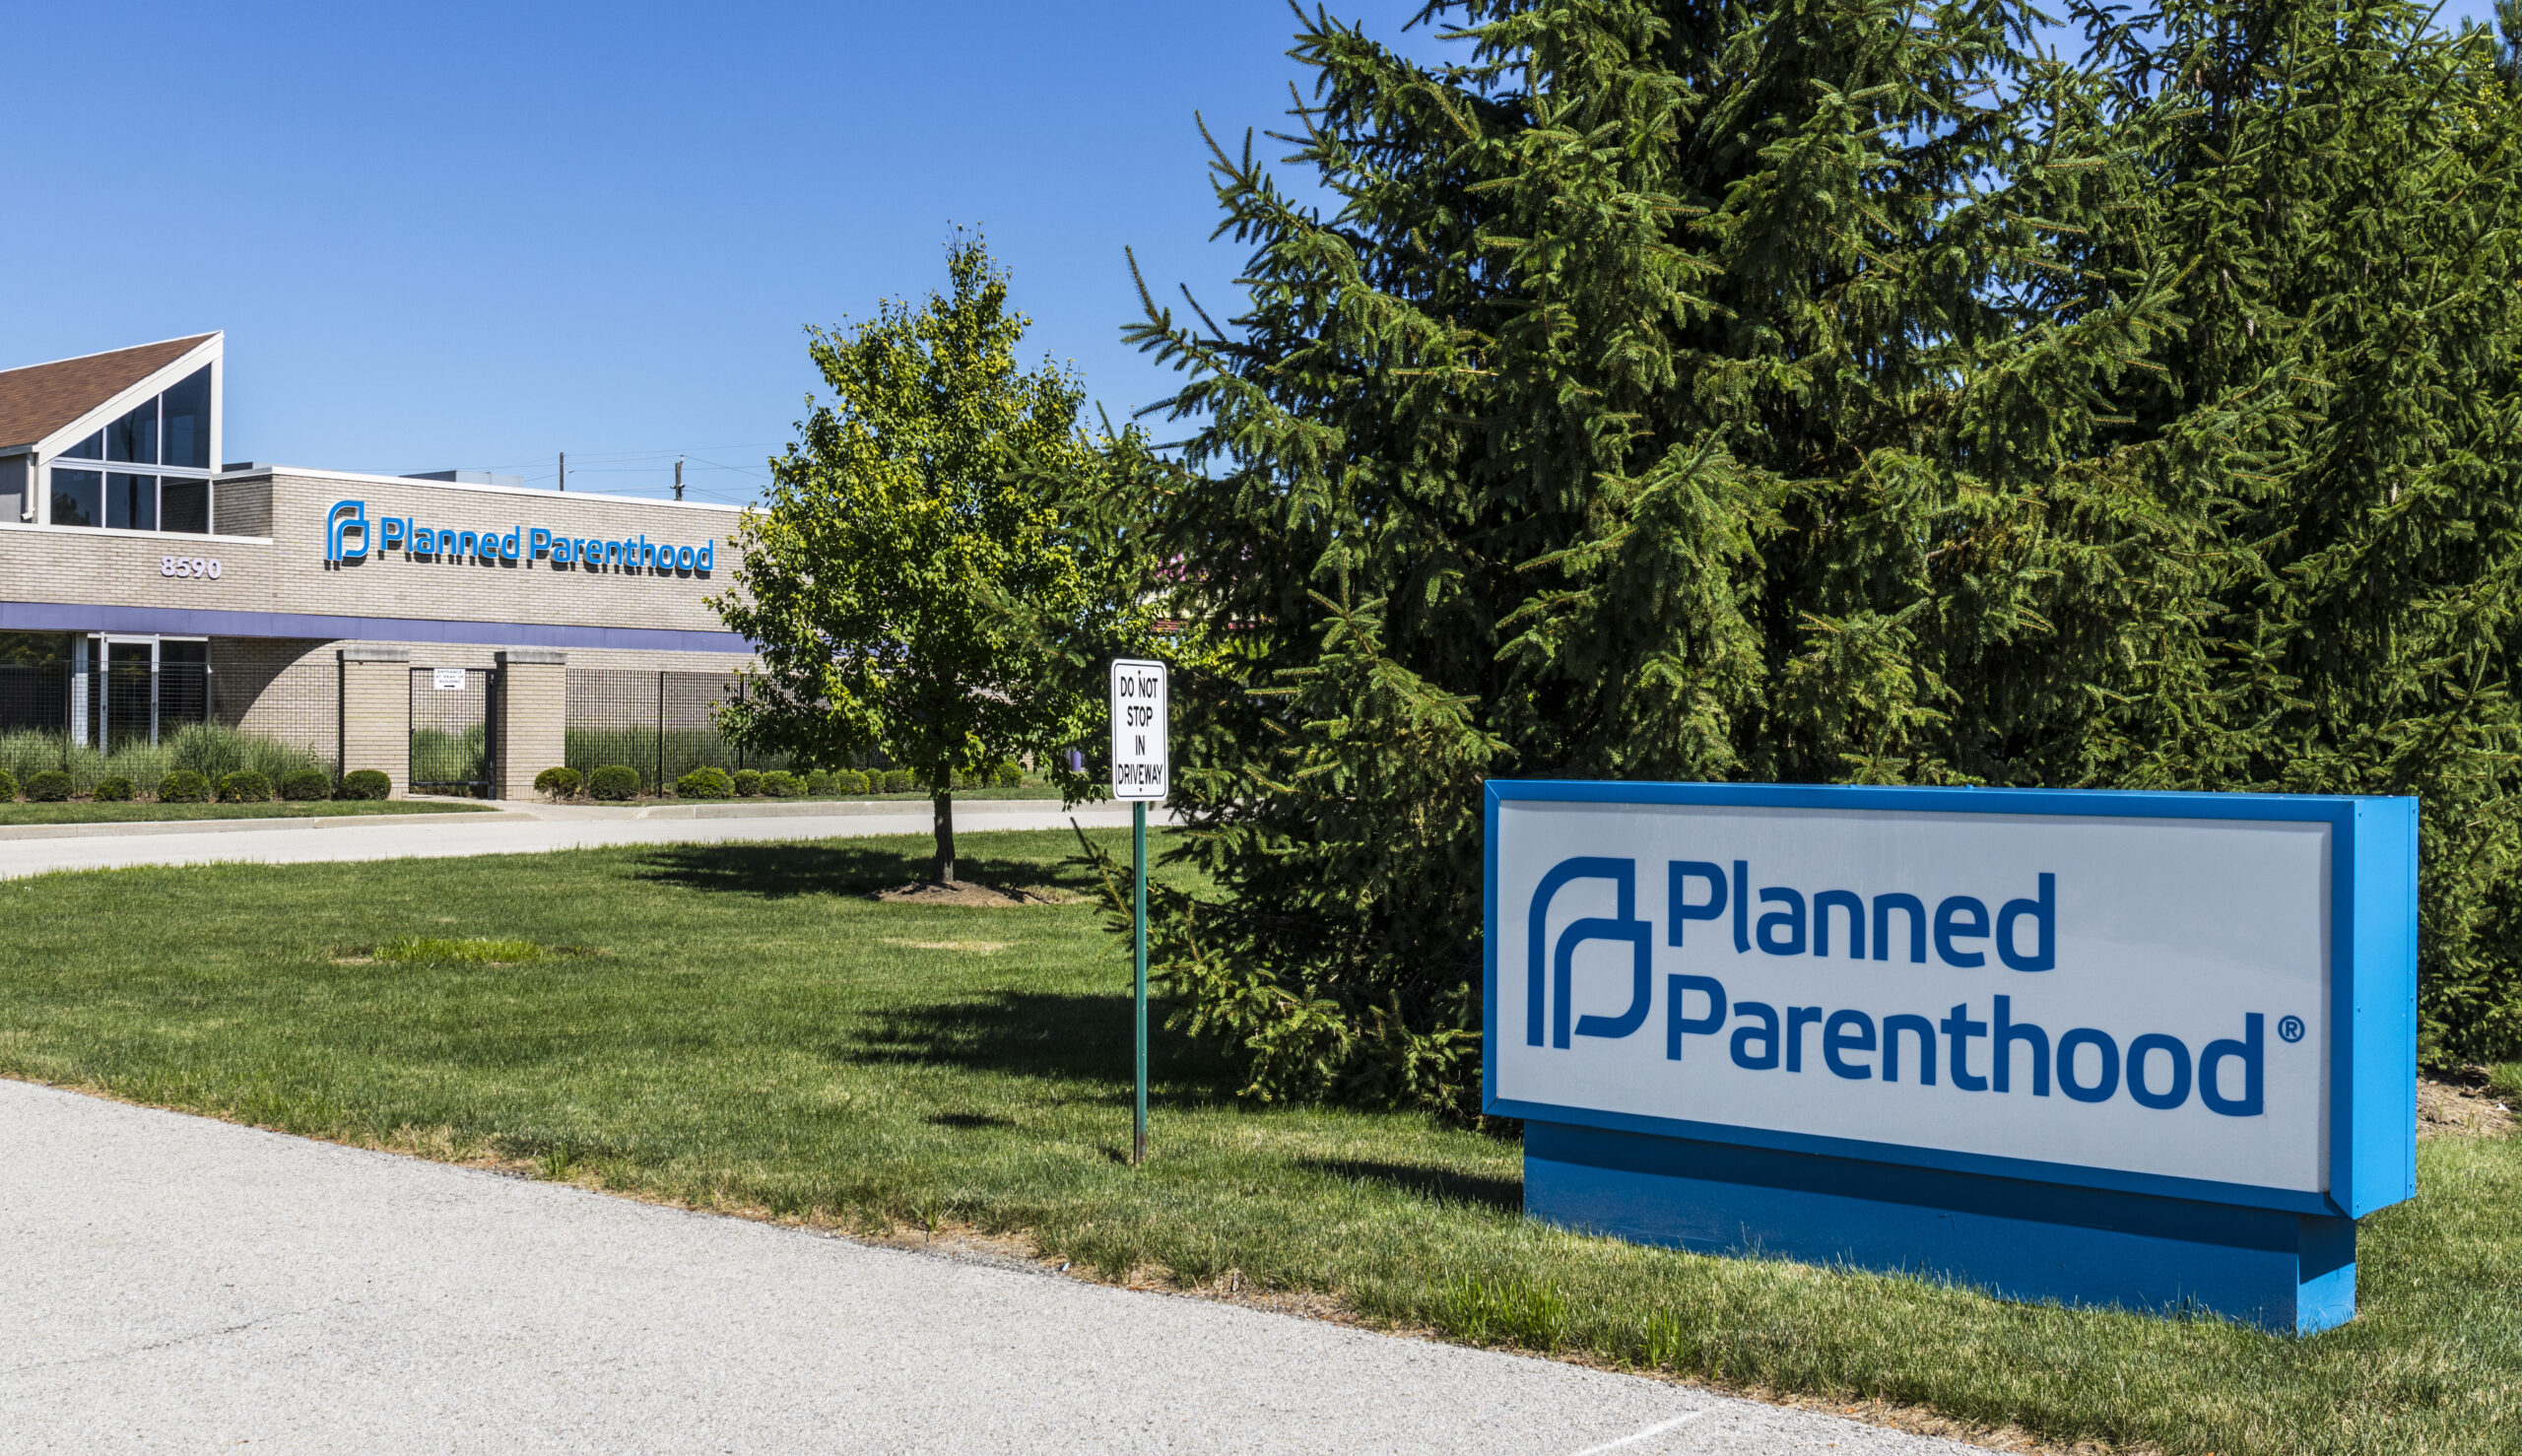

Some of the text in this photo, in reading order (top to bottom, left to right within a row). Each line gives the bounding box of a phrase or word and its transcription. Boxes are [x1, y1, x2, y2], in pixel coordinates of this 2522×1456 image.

[380, 516, 714, 571] Planned Parenthood
[161, 556, 222, 579] 8590
[1120, 676, 1159, 698] DO NOT
[1127, 705, 1153, 727] STOP
[1135, 735, 1146, 756] IN
[1118, 763, 1162, 785] DRIVEWAY
[1668, 860, 2055, 972] Planned
[1666, 973, 2265, 1117] Parenthood
